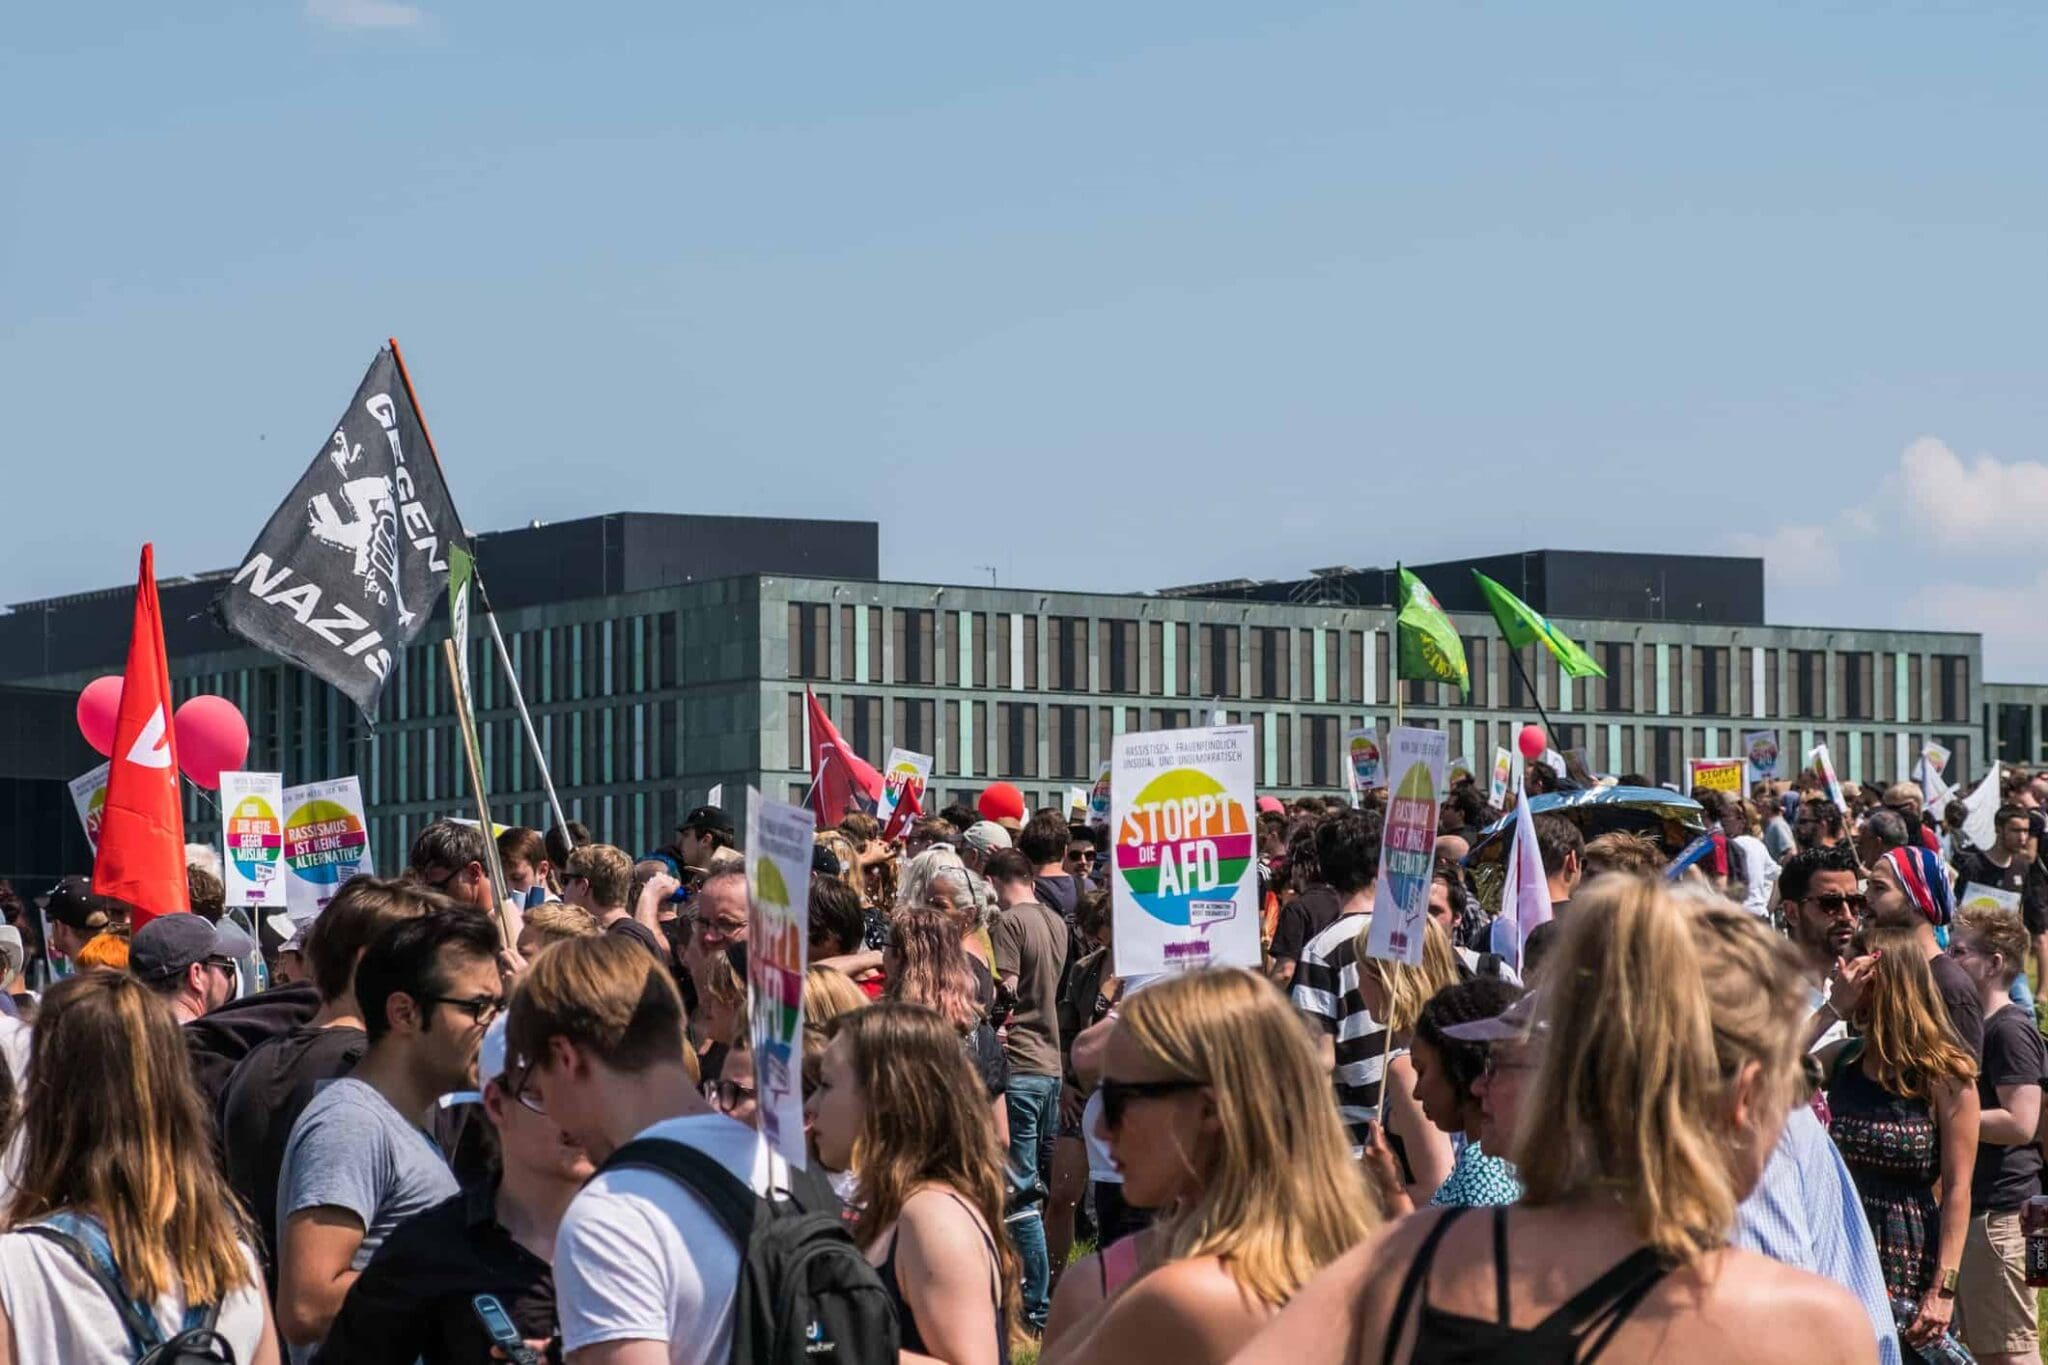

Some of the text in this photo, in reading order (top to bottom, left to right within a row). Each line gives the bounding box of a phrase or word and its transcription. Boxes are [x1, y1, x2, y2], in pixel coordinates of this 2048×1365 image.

[366, 393, 448, 572] GEGEN
[232, 552, 391, 685] NAZIS
[287, 819, 348, 841] RASSISMUS
[1124, 791, 1235, 847] STOPPT
[294, 835, 342, 855] IST KEINE
[295, 847, 360, 869] ALTERNATIVE
[1139, 845, 1156, 863] DIE
[1157, 838, 1220, 899] AFD
